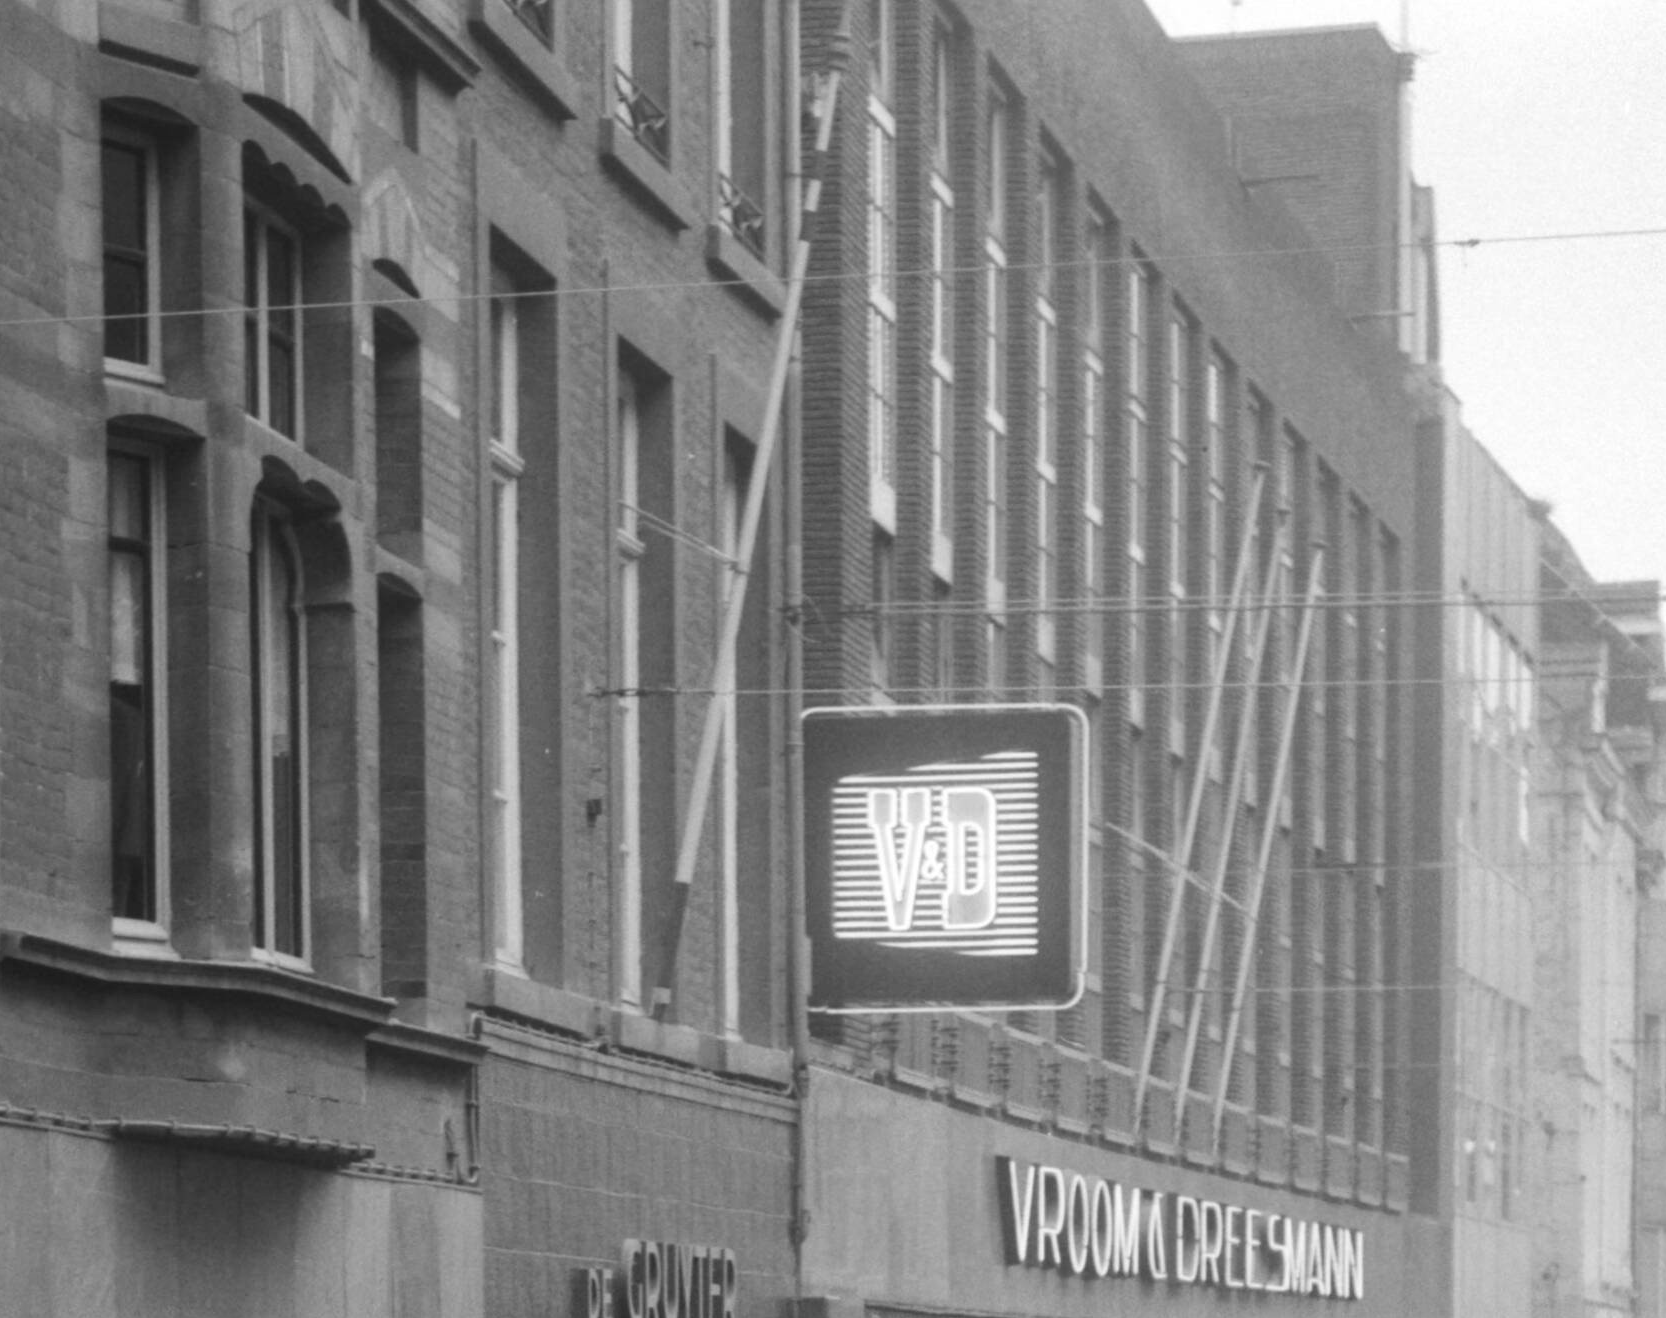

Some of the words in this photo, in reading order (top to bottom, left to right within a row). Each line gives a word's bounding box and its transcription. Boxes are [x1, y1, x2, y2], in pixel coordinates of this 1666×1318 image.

[866, 785, 997, 931] V&D
[1008, 1160, 1141, 1277] VROOM
[1176, 1195, 1365, 1301] DREESMANN
